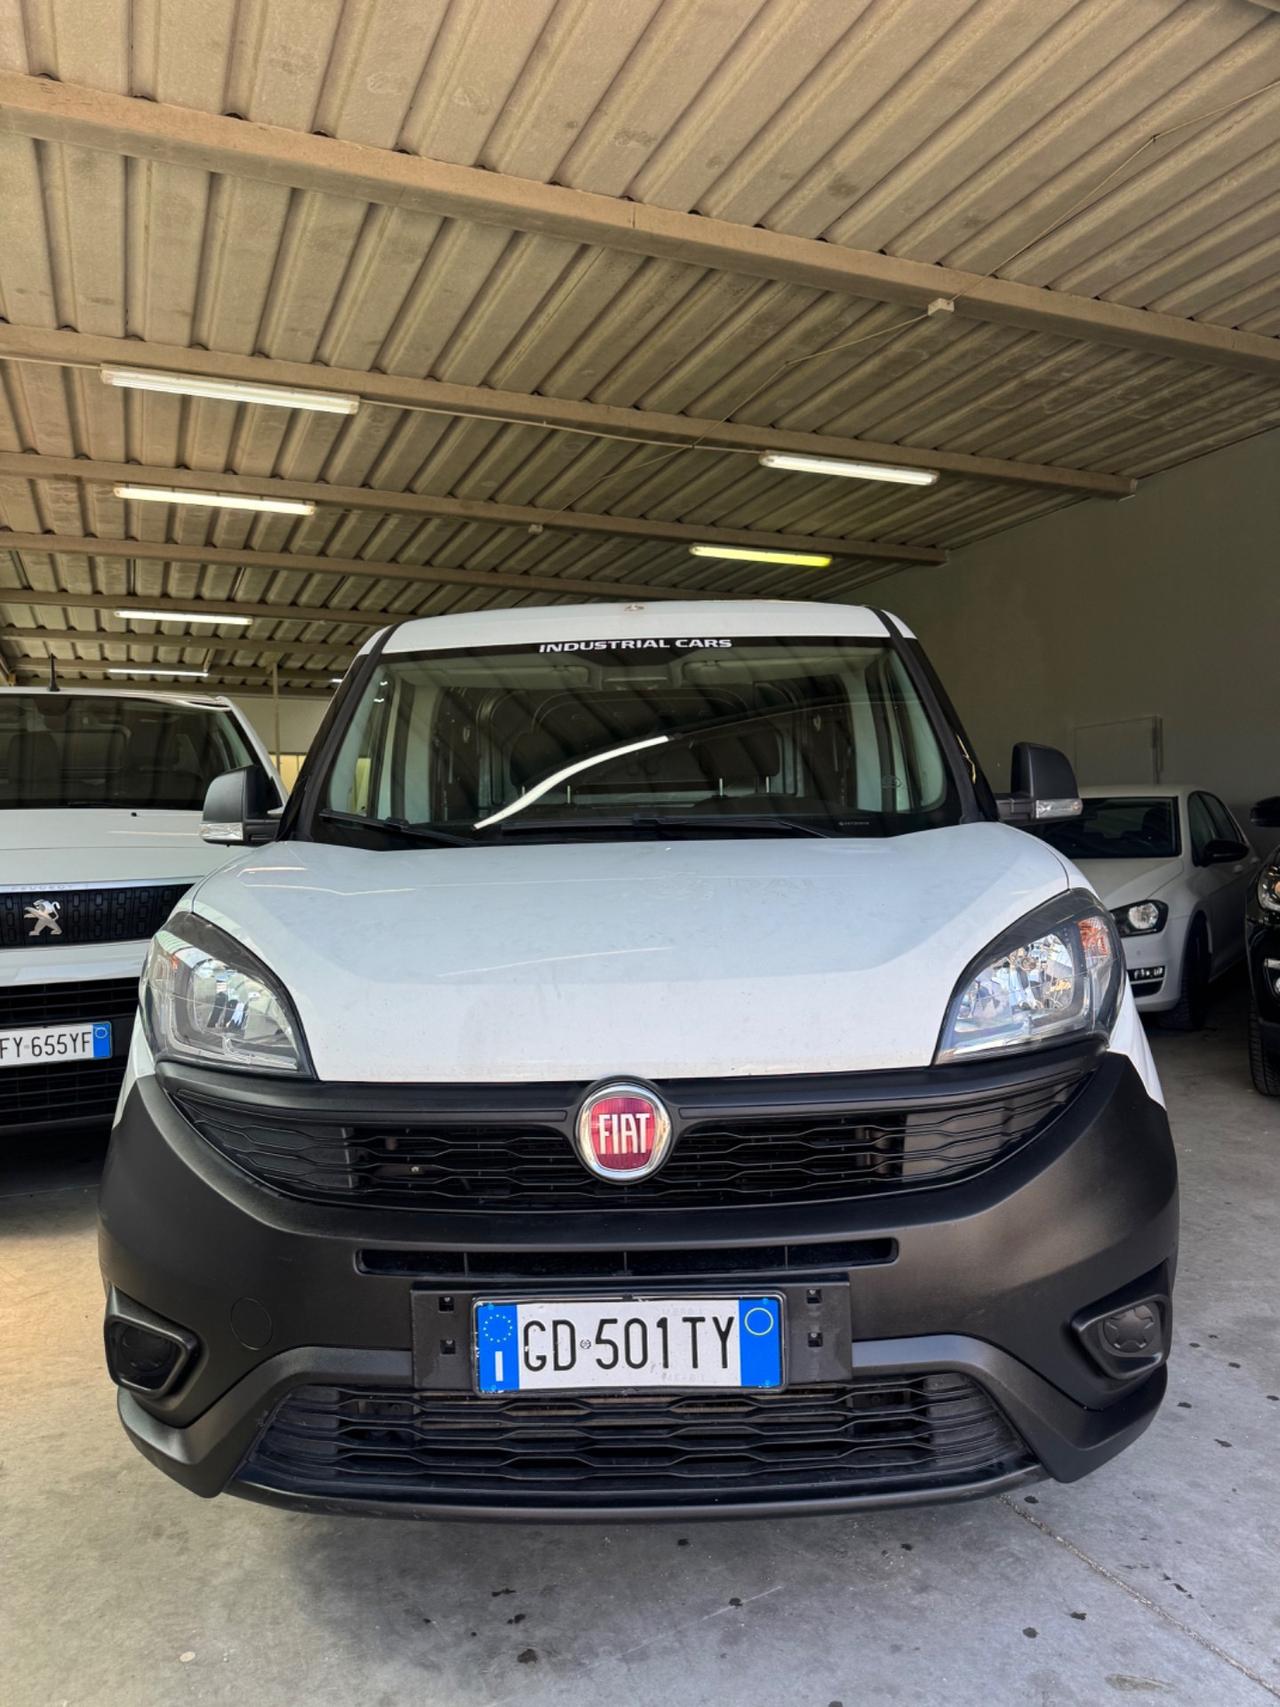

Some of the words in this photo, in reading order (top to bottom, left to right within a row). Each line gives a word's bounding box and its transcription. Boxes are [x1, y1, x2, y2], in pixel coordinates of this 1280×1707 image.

[538, 639, 670, 653] INDUSTRIAL
[675, 638, 733, 649] CARS
[598, 1113, 651, 1155] FIAT
[523, 1318, 577, 1372] GD
[594, 1316, 735, 1370] 501TY
